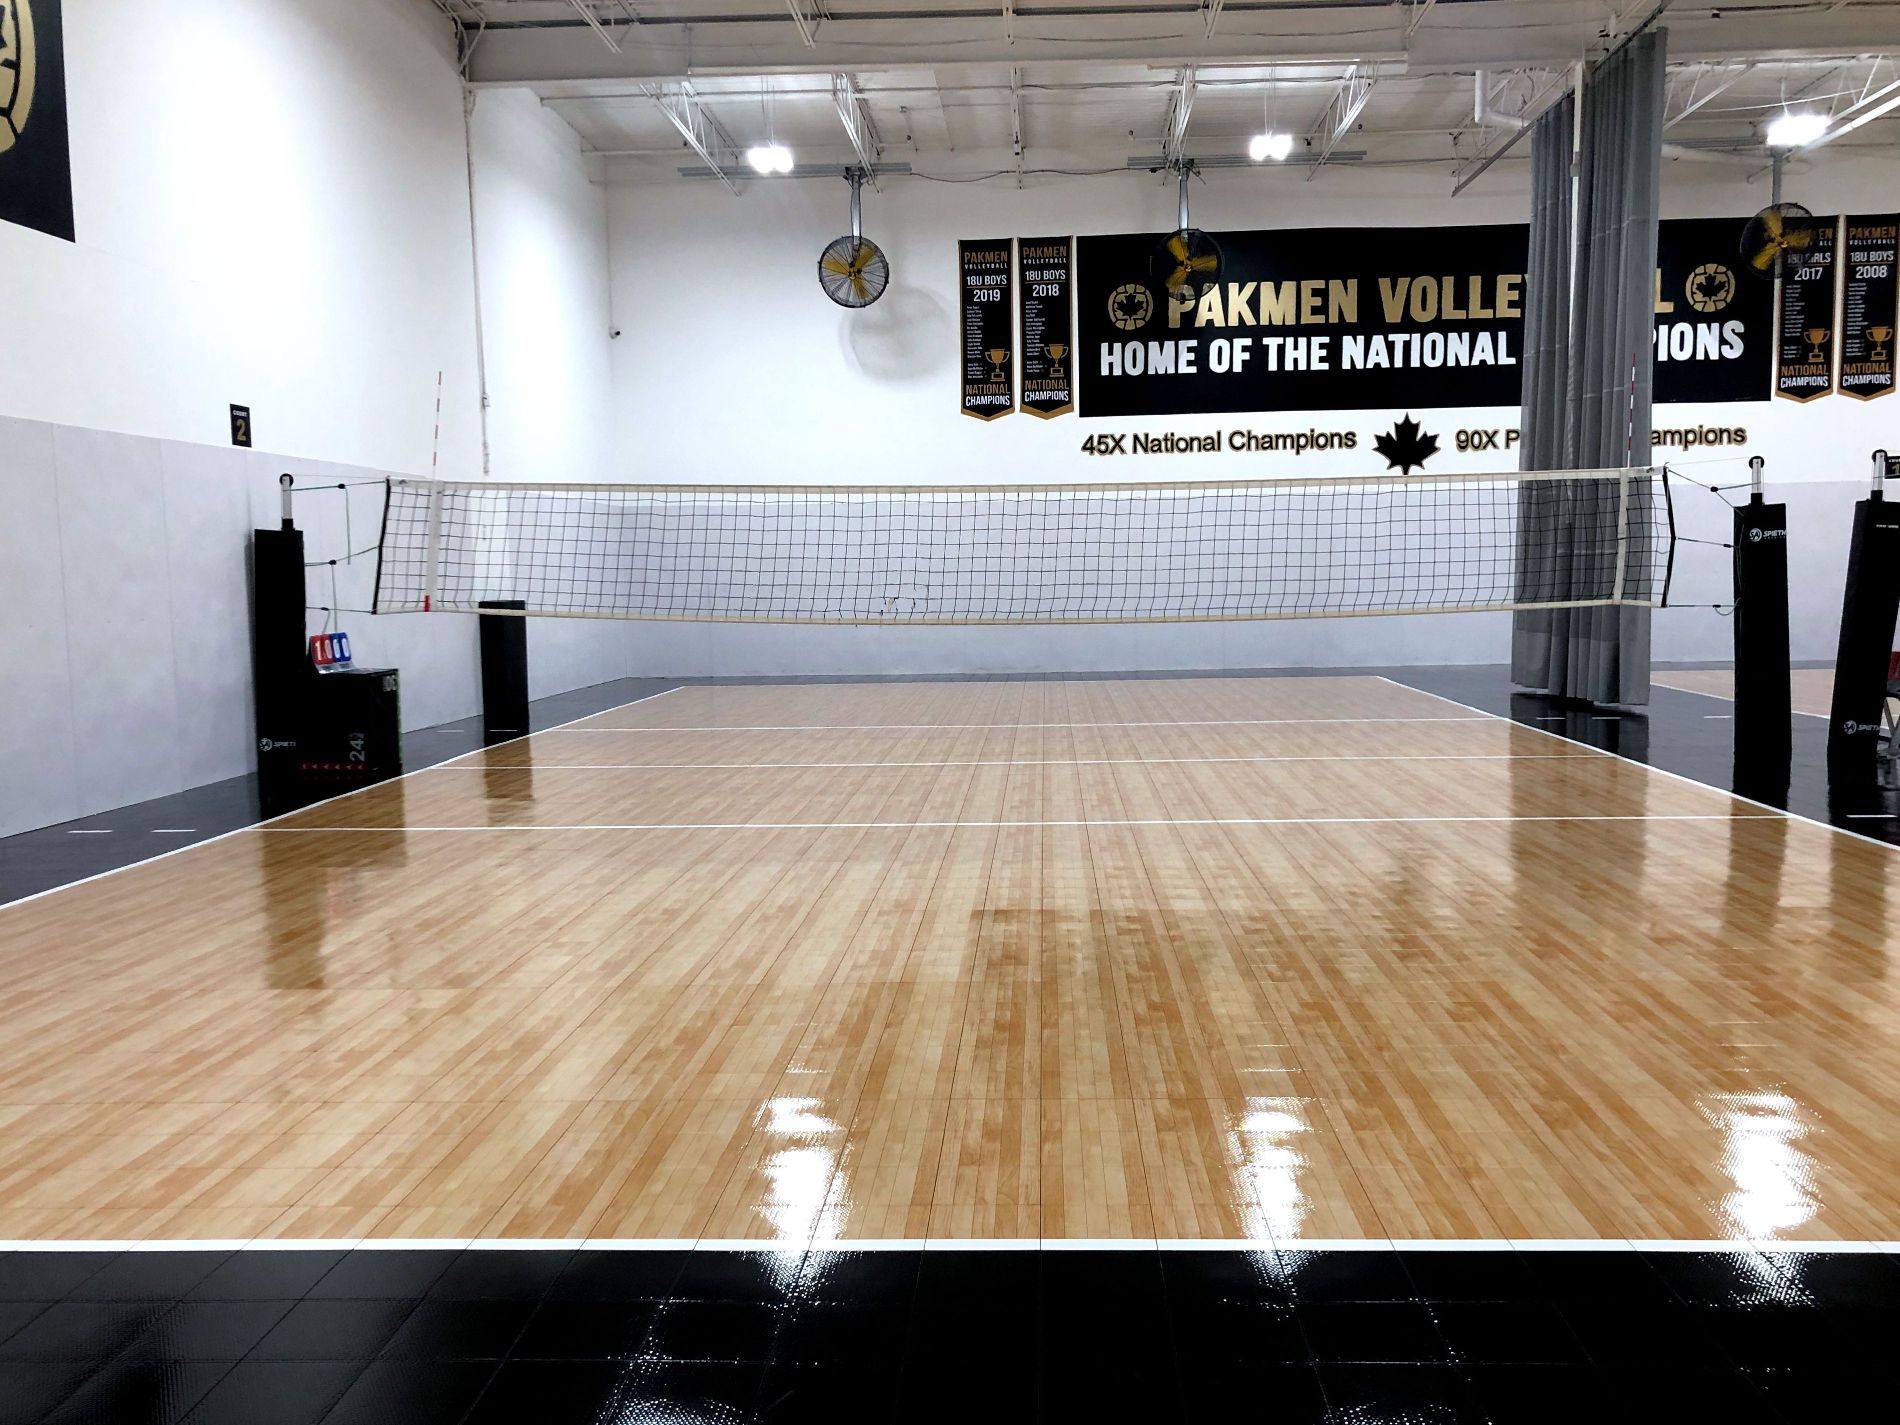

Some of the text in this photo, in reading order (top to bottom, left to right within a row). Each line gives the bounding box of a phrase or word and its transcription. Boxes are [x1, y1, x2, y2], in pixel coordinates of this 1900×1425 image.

[1850, 226, 1896, 239] PAKMEN
[964, 251, 1008, 264] PAKMEN
[1023, 246, 1067, 258] PAKMEN
[1850, 250, 1894, 262] 18U BOYS
[1024, 269, 1066, 281] 18U BOYS
[1794, 267, 1823, 281] 2017
[1855, 266, 1888, 279] 2008
[966, 275, 1007, 286] 18U BOYS
[973, 289, 1001, 302] 2019
[1032, 284, 1060, 297] 2018
[1168, 279, 1358, 328] PAKMEN
[1101, 340, 1197, 376] HOME
[1209, 338, 1252, 373] OF
[1263, 336, 1330, 371] THE
[1342, 331, 1516, 369] NATIONAL
[1781, 364, 1829, 376] NATIONAL
[1843, 362, 1891, 374] NATIONAL
[1024, 379, 1069, 390] NATIONAL
[1780, 376, 1829, 388] CHAMPIONS
[1842, 374, 1891, 387] CHAMPIONS
[965, 384, 1010, 395] NATIONAL
[965, 396, 1010, 407] CHAMPIONS
[1024, 391, 1069, 402] CHAMPIONS
[236, 419, 247, 441] 2
[1081, 428, 1357, 456] 45X National Champions
[1456, 429, 1499, 451] 90X
[1652, 425, 1747, 451] ampions
